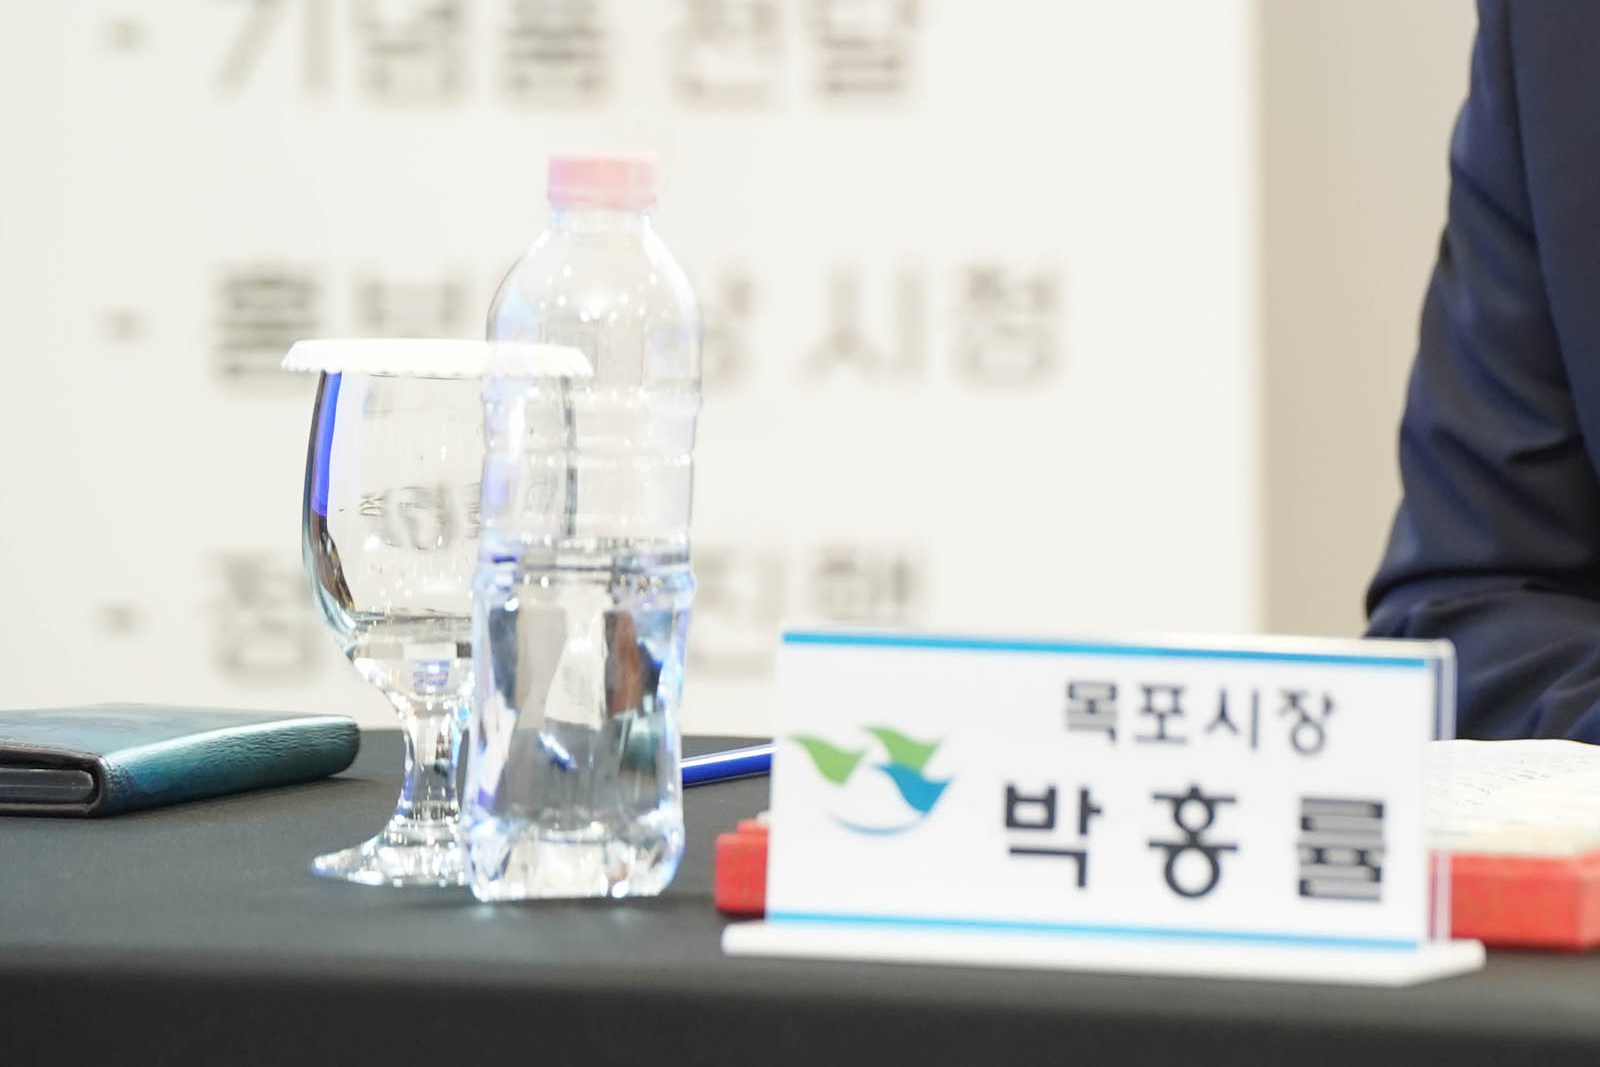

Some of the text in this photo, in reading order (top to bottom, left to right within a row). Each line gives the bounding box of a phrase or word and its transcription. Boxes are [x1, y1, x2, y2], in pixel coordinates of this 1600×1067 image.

[800, 262, 1065, 392] 시청
[1064, 680, 1336, 755] 목포시장
[1003, 782, 1387, 902] 박홍률
